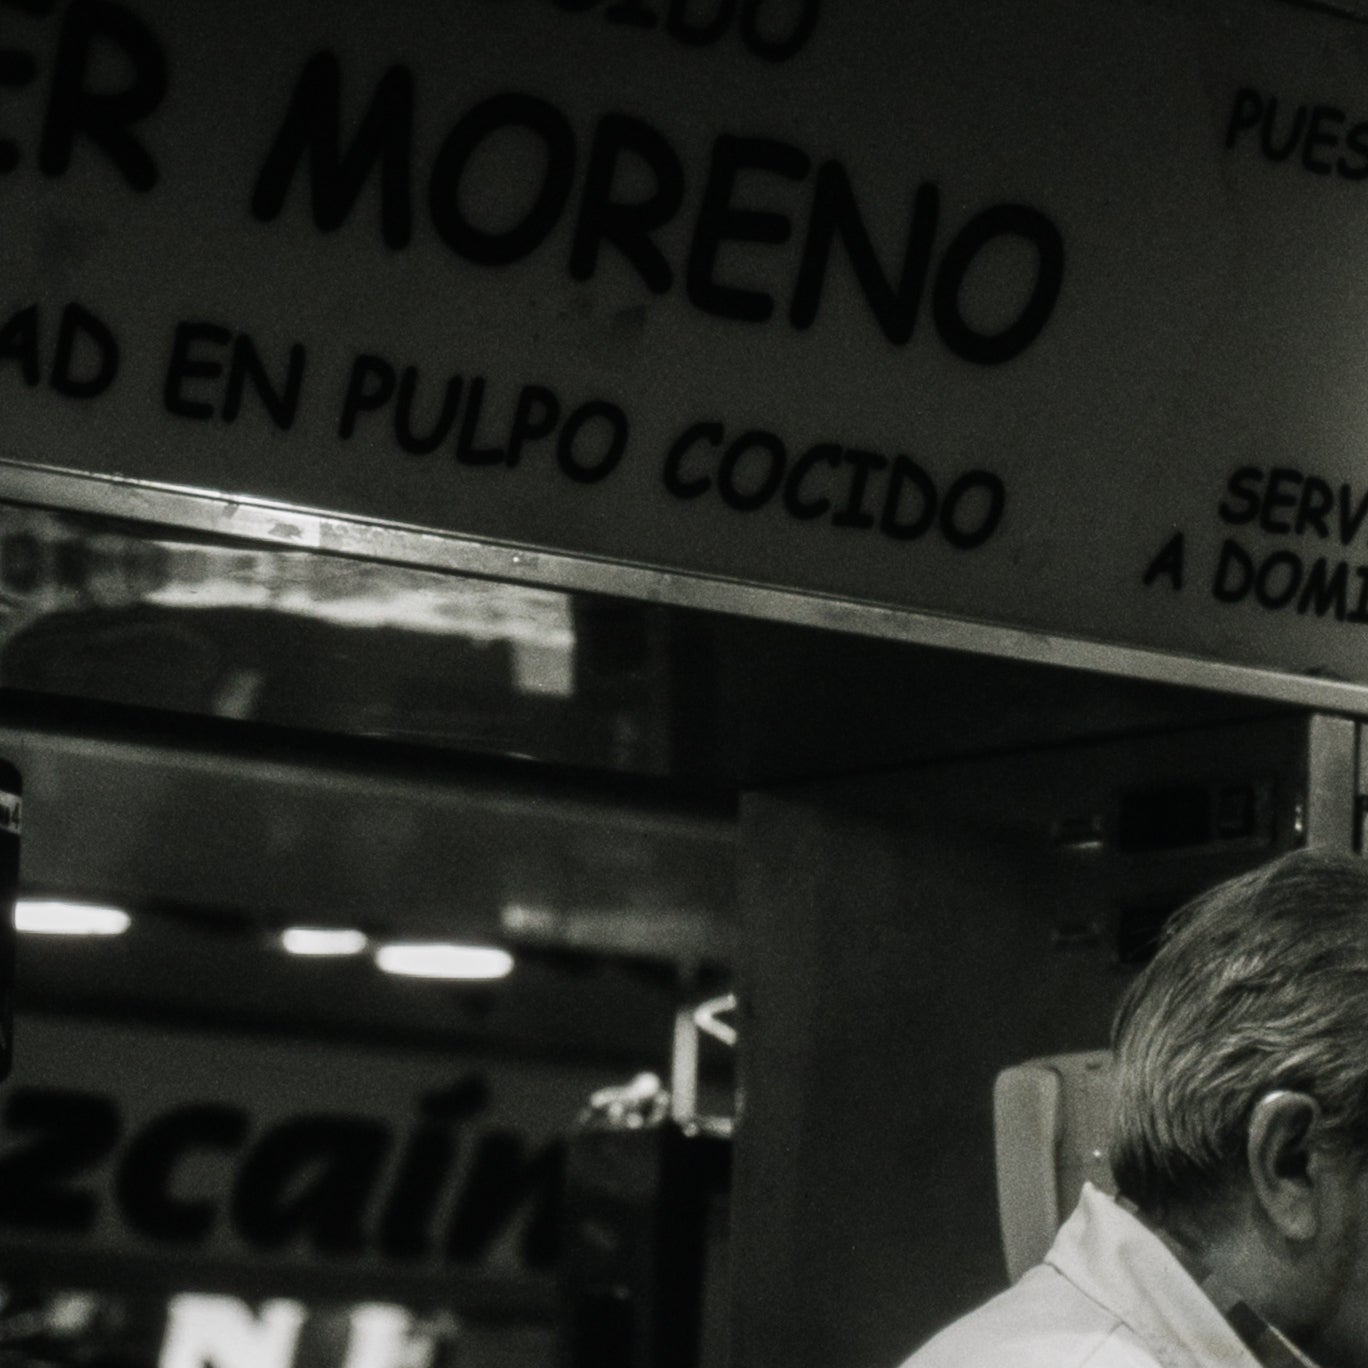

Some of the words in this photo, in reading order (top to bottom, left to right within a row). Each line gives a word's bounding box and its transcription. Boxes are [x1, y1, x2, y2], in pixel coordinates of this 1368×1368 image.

[252, 50, 1064, 366] MORENO
[164, 320, 305, 431] EN
[337, 355, 629, 484] PULPO
[662, 422, 1006, 550] COCIDO
[1143, 532, 1186, 591] A
